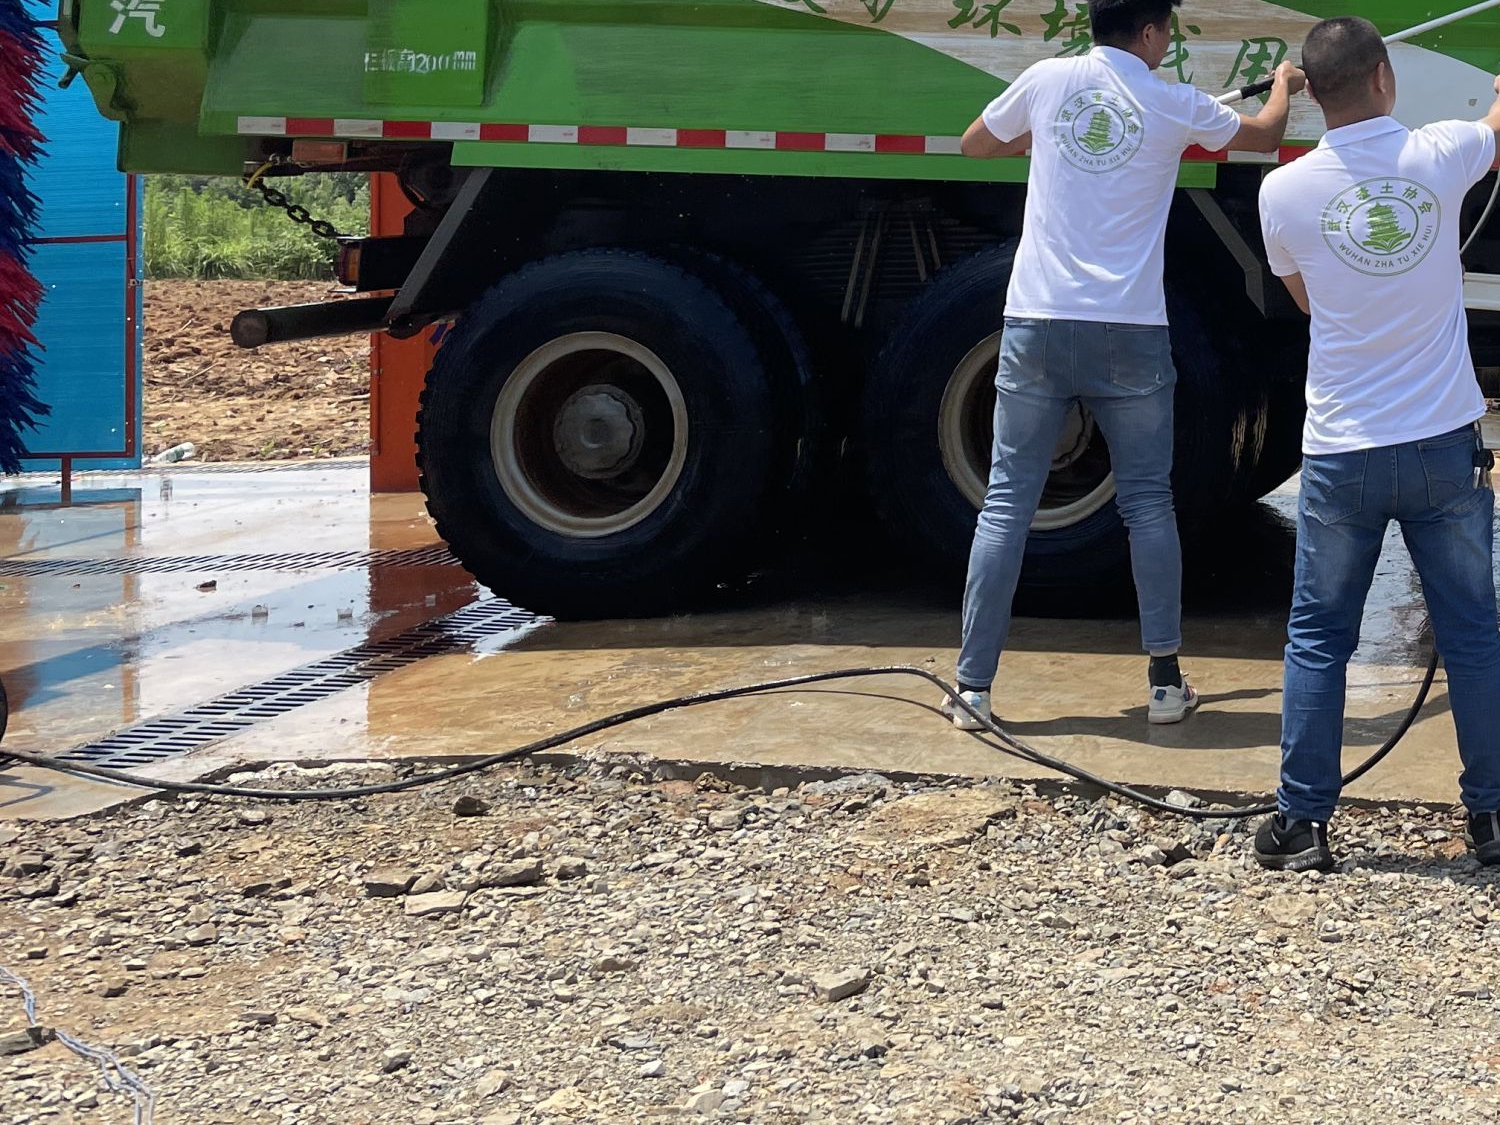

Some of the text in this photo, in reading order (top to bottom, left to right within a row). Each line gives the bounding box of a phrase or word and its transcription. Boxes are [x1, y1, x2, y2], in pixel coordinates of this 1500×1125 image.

[1078, 156, 1094, 167] ZHA
[1096, 159, 1107, 167] TU
[1338, 225, 1433, 268] WUHAN ZHA TU XIE HUI
